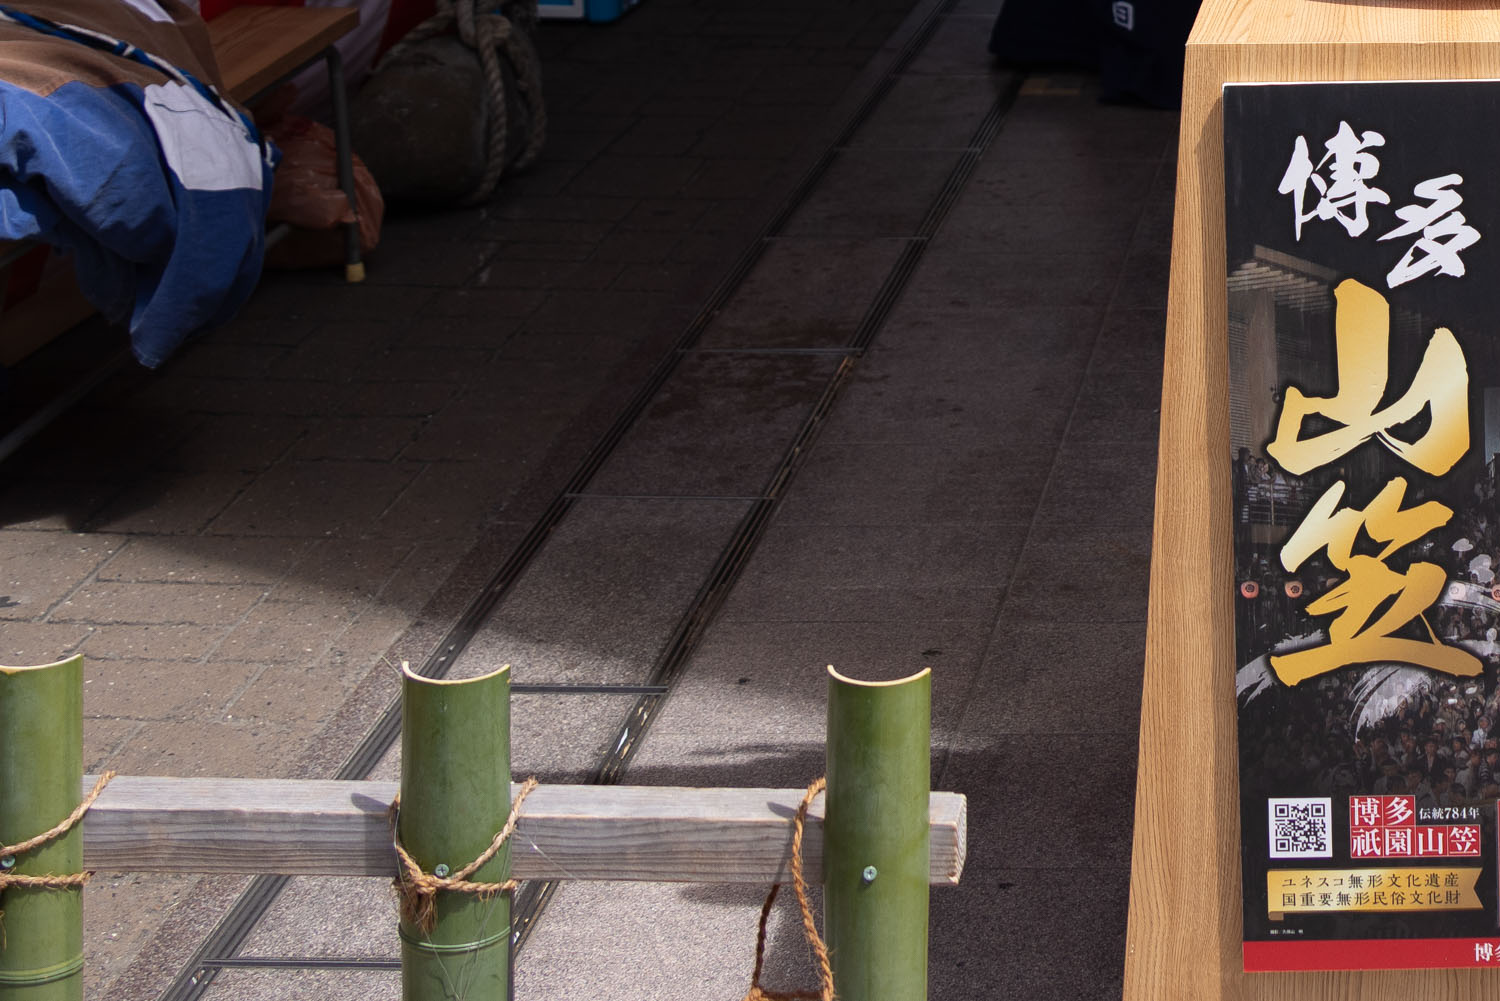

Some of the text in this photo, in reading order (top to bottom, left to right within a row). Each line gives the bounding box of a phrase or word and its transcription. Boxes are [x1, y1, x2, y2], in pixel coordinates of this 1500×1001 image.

[1278, 120, 1482, 288] 博多
[1266, 278, 1484, 687] 山笠
[1351, 797, 1413, 826] 博多
[1419, 807, 1480, 821] 伝統784年
[1351, 827, 1479, 856] 祇園山笠
[1282, 872, 1460, 889] ユネスコ無形文化遺産
[1282, 890, 1461, 907] 国重要無形民俗文化財
